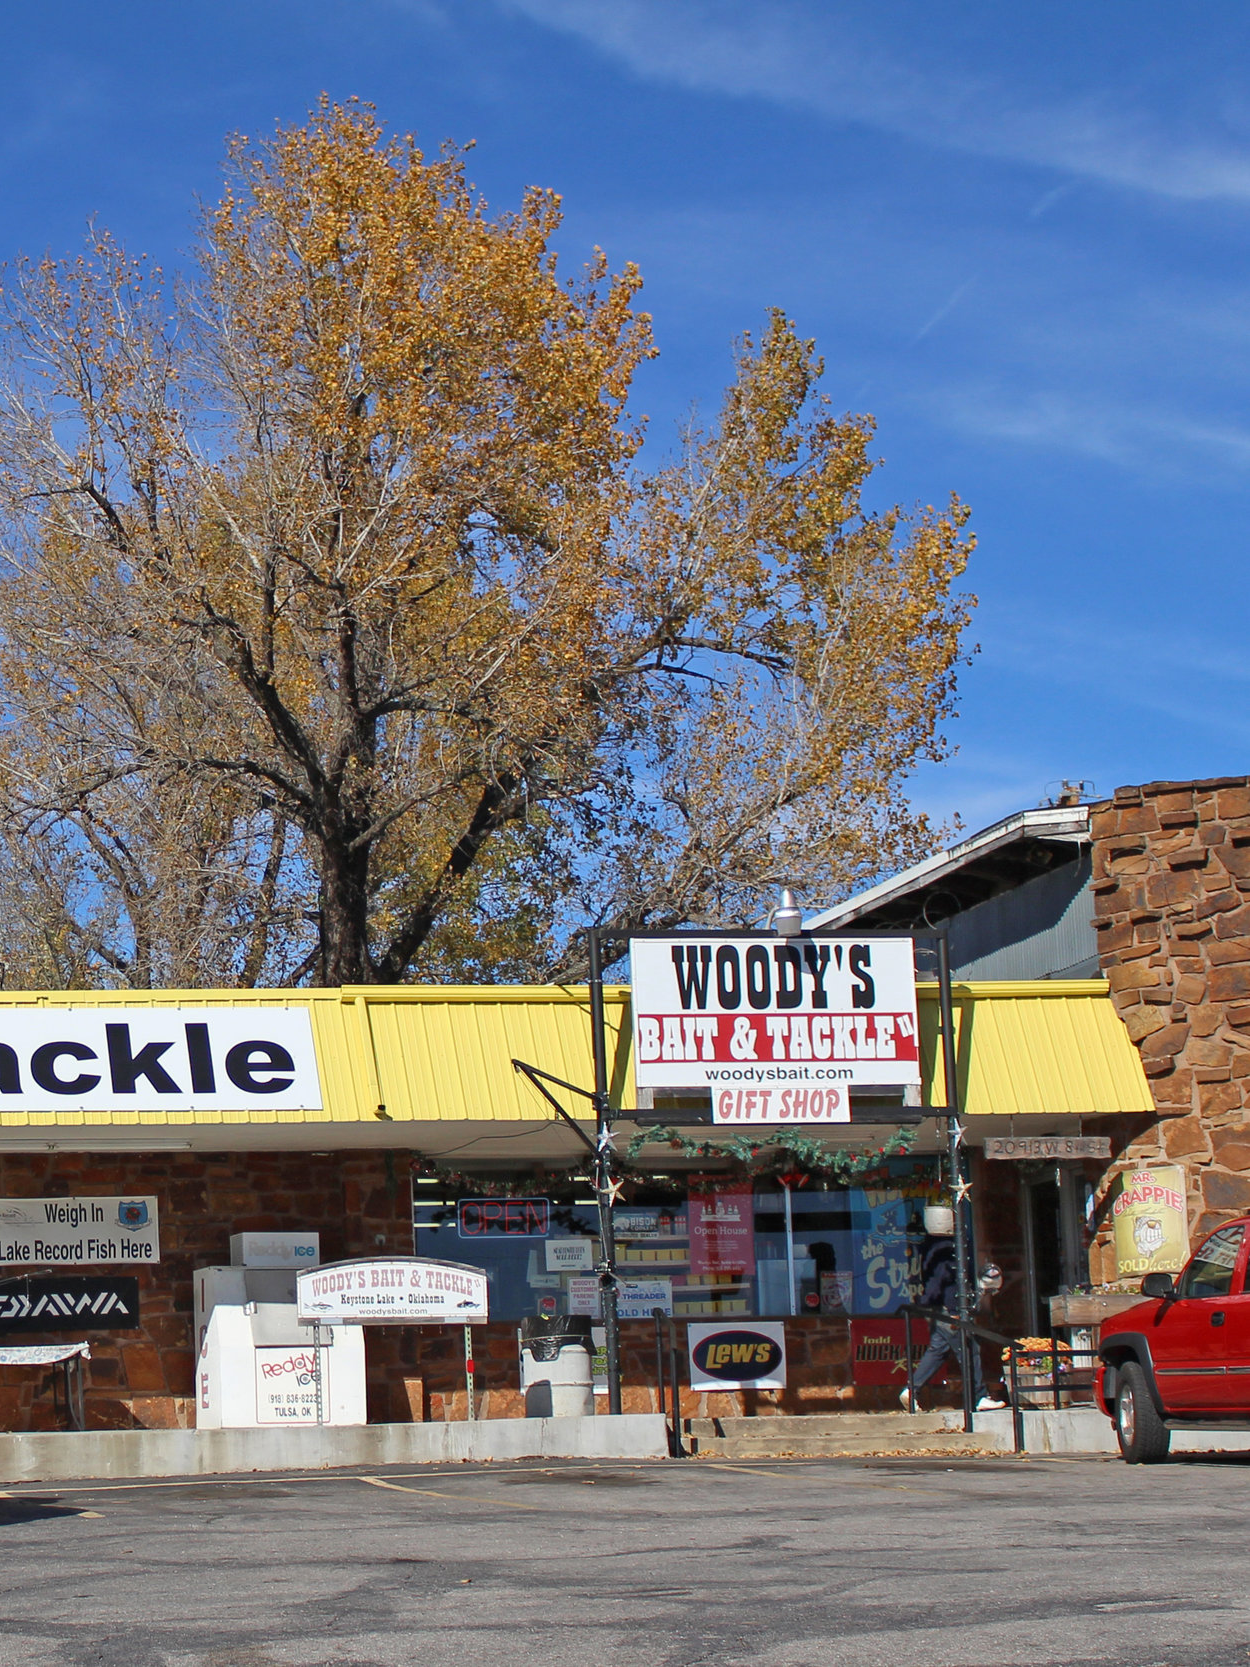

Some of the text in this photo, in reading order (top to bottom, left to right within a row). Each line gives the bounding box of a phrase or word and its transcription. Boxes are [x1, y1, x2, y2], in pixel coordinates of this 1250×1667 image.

[671, 944, 876, 1010] WOODY'S
[638, 1015, 718, 1061] BAIT
[729, 1016, 758, 1060] &
[766, 1015, 897, 1060] TACKLE
[705, 1066, 854, 1083] woodysbait.com
[718, 1088, 841, 1119] GIFT SHOP
[1131, 1171, 1156, 1184] MR.
[1113, 1186, 1184, 1217] CRAPPIE
[44, 1203, 87, 1228] Weigh
[91, 1203, 104, 1222] In
[461, 1201, 547, 1235] OPEN
[694, 1226, 748, 1236] Open House
[35, 1240, 83, 1260] Record
[87, 1239, 117, 1259] Fish
[121, 1238, 152, 1259] Here
[861, 1239, 884, 1260] the
[1118, 1258, 1149, 1274] SOLD
[312, 1270, 366, 1298] WOODY'S
[370, 1269, 405, 1289] BAIT
[409, 1269, 422, 1289] &
[425, 1270, 473, 1297] TACKLE
[341, 1294, 445, 1307] Keystone Lake Oklahoma
[359, 1308, 428, 1316] woodysbait.com
[616, 1308, 639, 1317] OLD
[261, 1353, 317, 1379] Reddy
[268, 1394, 285, 1403] (918)
[275, 1407, 312, 1417] TULSA, OK
